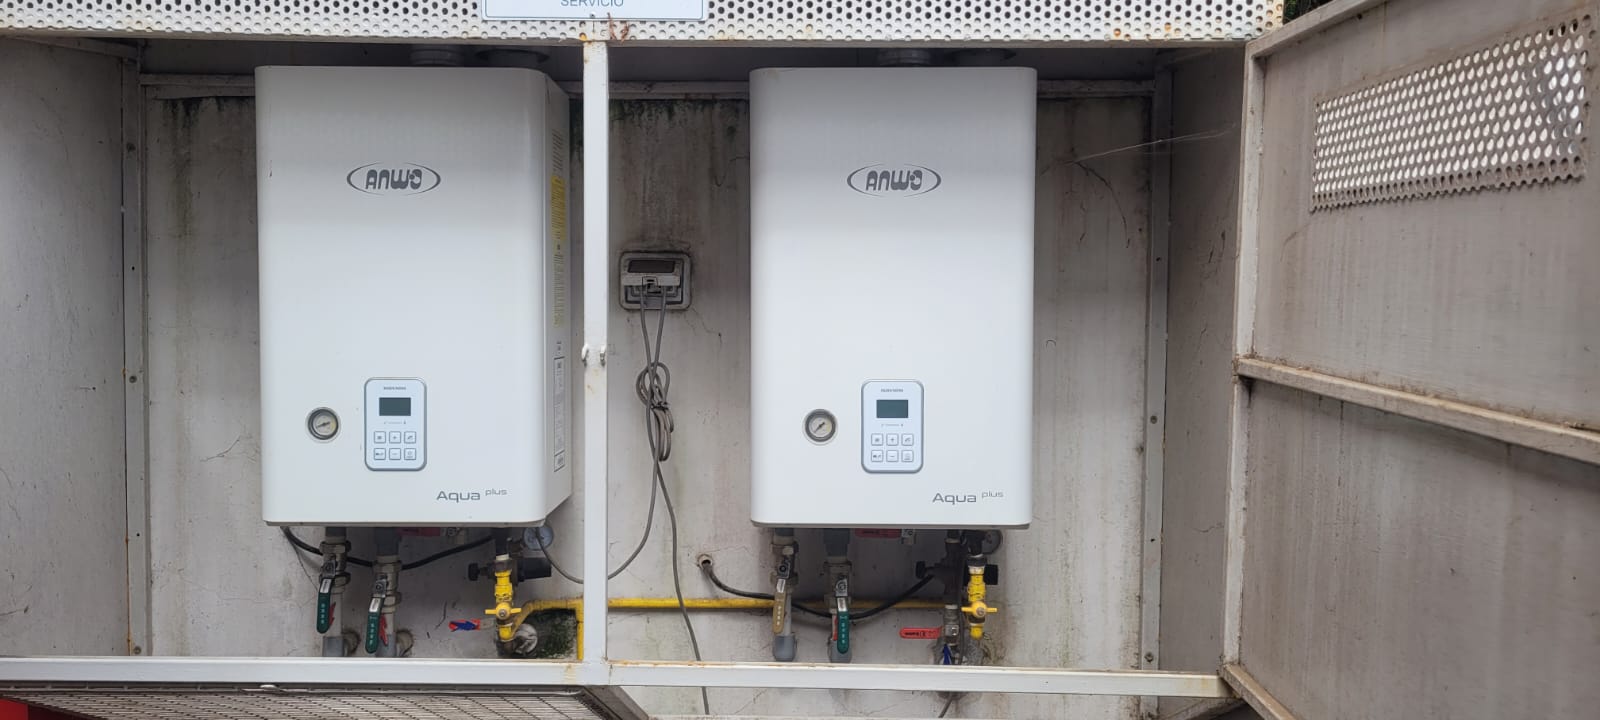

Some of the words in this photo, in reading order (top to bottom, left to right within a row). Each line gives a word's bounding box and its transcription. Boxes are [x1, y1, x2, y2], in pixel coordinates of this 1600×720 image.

[365, 168, 422, 190] ANWO
[865, 169, 922, 191] ANWO
[436, 490, 481, 503] Aqua
[485, 488, 508, 496] plus
[932, 492, 977, 505] Aqua
[981, 490, 1004, 499] plus
